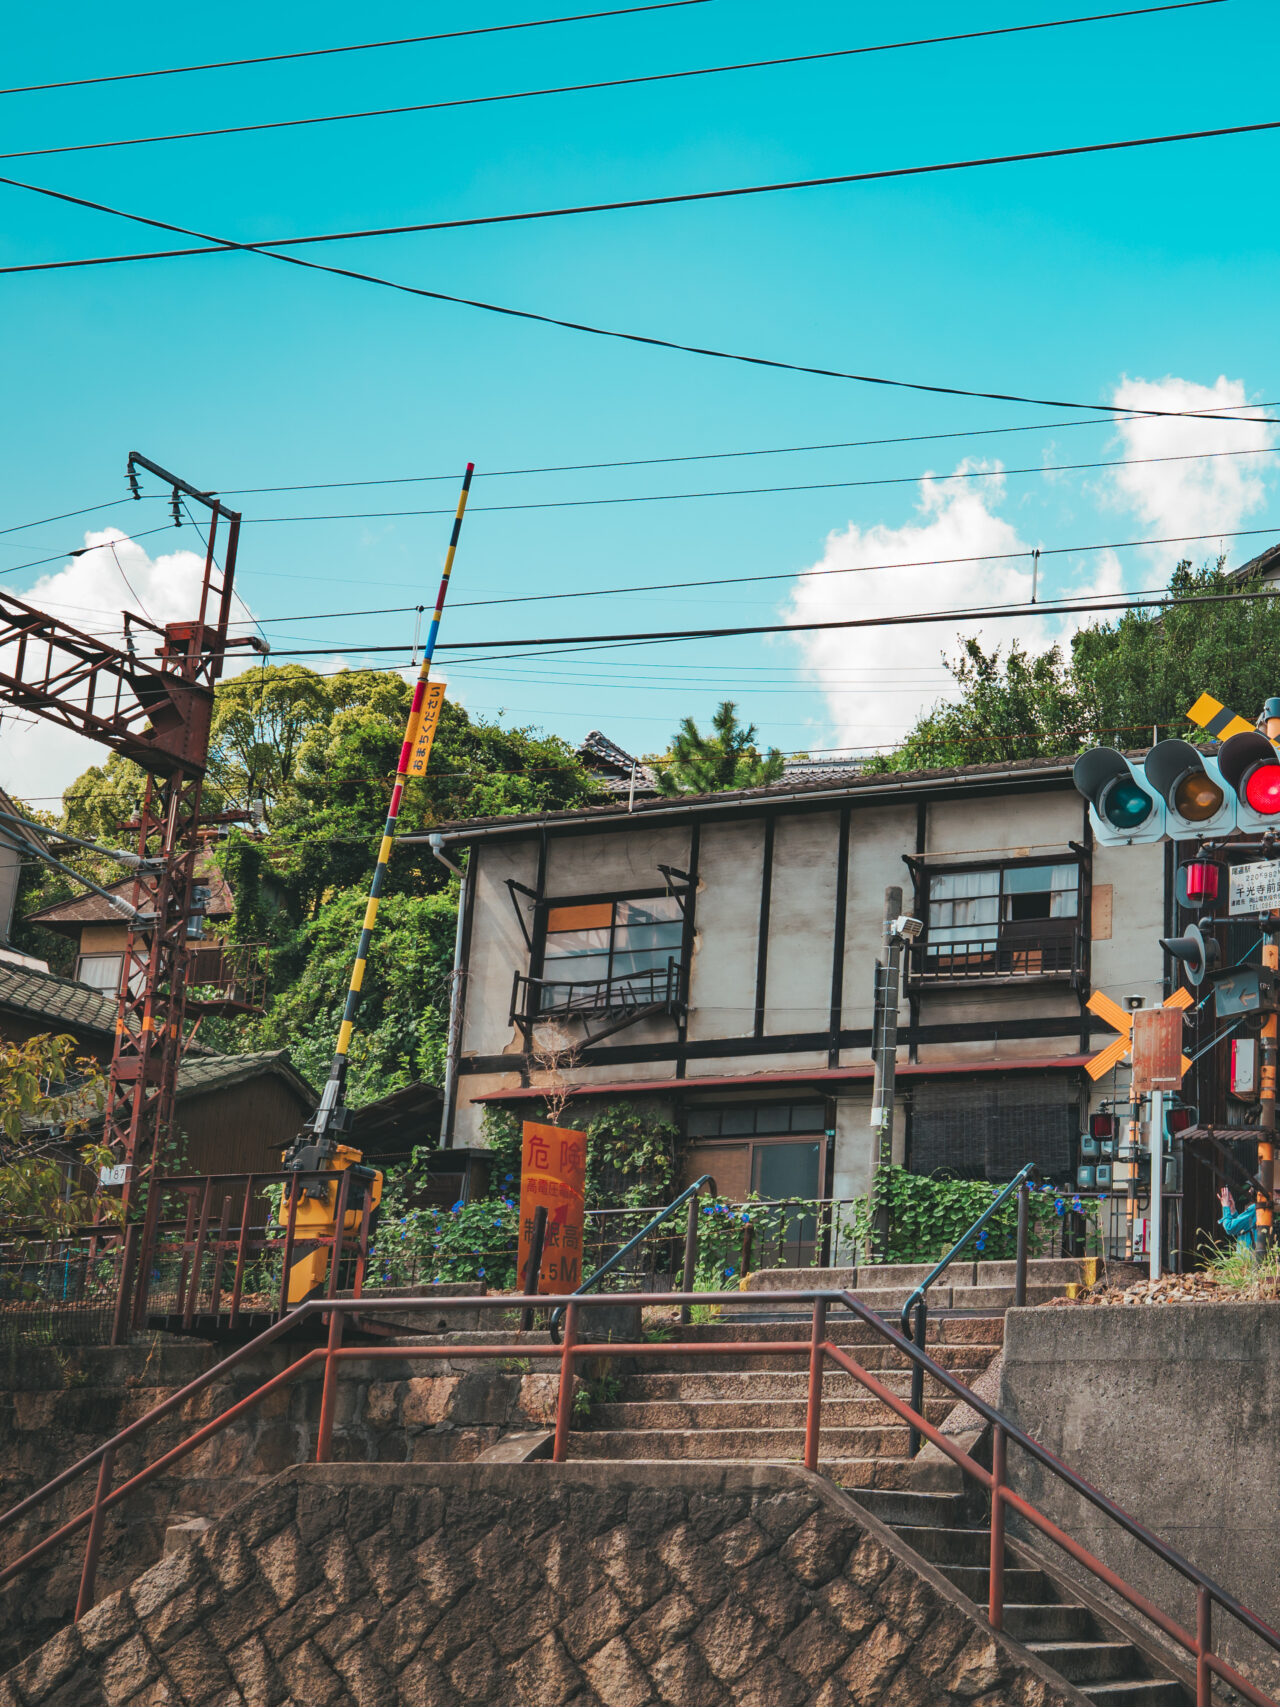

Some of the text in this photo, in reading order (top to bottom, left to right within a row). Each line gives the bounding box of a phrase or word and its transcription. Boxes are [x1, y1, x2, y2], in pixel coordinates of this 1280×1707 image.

[413, 686, 441, 770] おまちください
[527, 1134, 583, 1173] 危険
[521, 1255, 578, 1282] .5M
